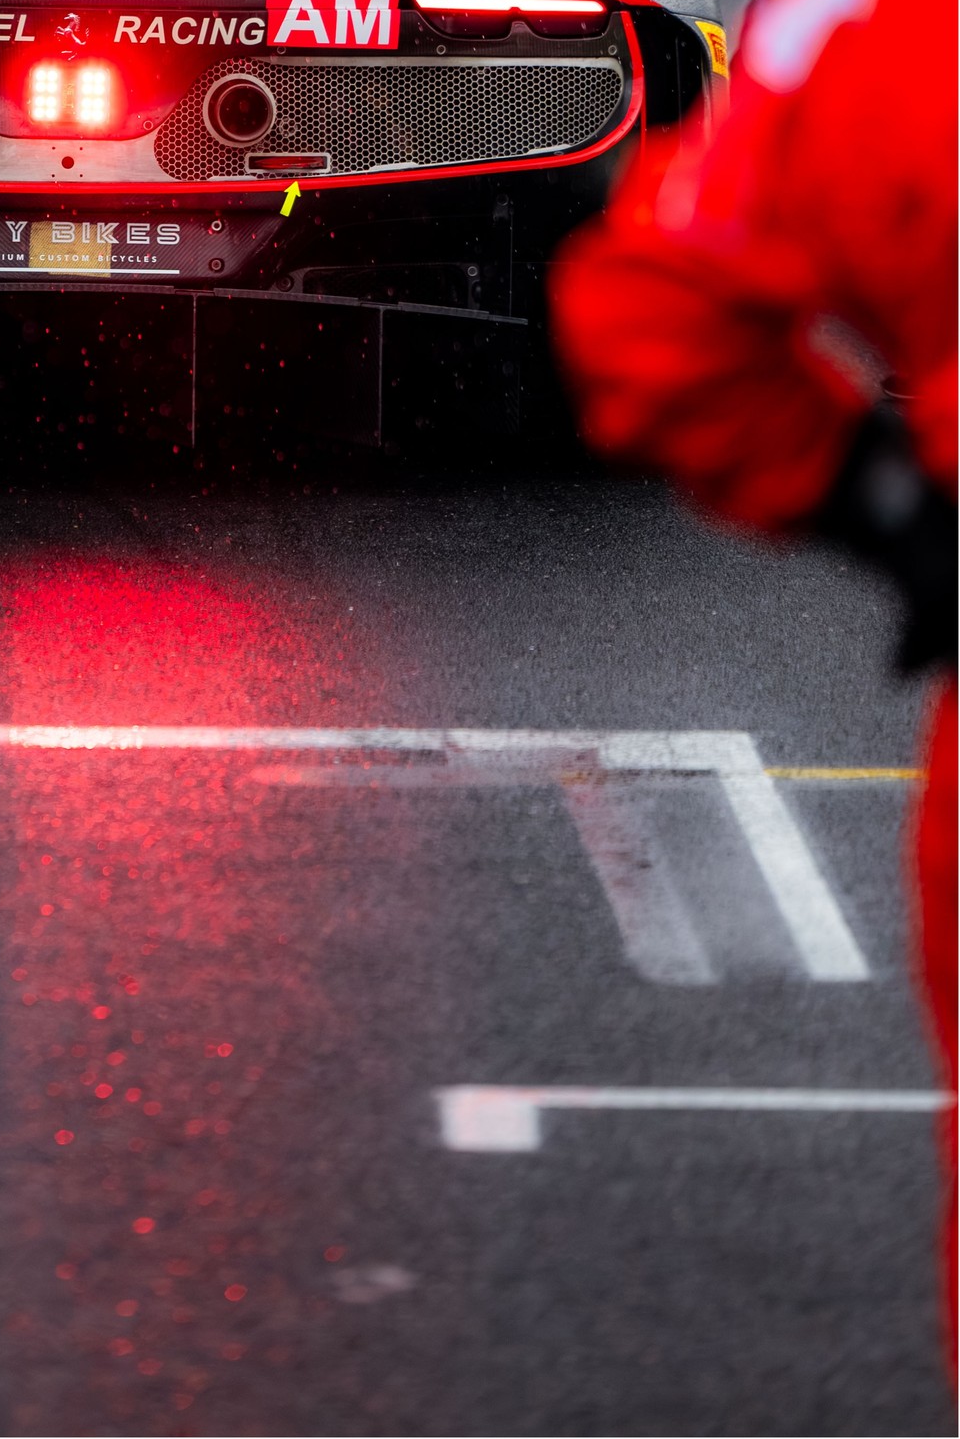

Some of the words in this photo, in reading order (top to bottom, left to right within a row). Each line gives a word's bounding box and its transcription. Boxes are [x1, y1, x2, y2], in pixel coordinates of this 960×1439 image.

[113, 15, 266, 46] RACING
[50, 221, 181, 245] BIKES
[39, 253, 90, 262] CUSTOM
[98, 255, 158, 263] BICYCLES
